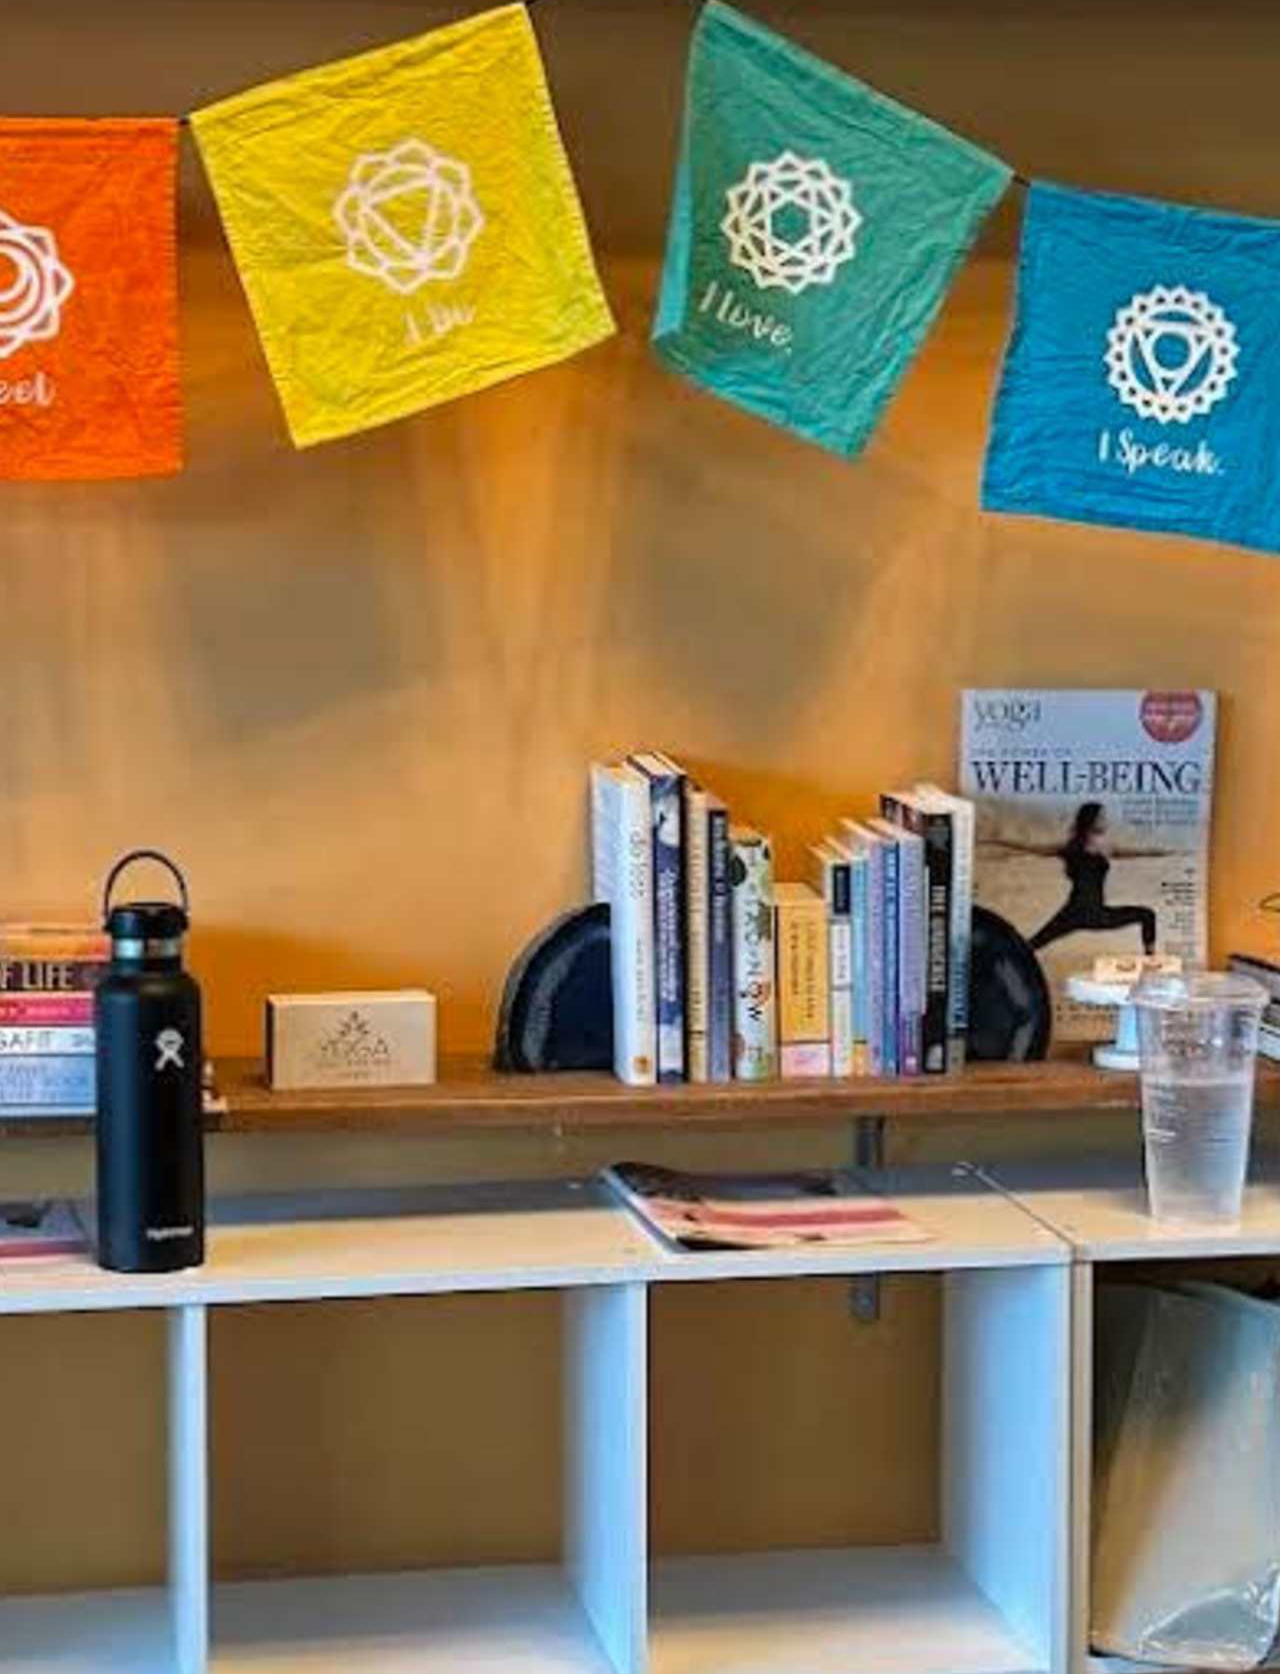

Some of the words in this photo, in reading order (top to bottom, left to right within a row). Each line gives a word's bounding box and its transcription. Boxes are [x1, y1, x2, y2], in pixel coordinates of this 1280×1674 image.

[697, 281, 718, 313] I
[1098, 429, 1111, 463] I
[972, 760, 1202, 795] WELL-BEING
[22, 960, 72, 988] LIFE
